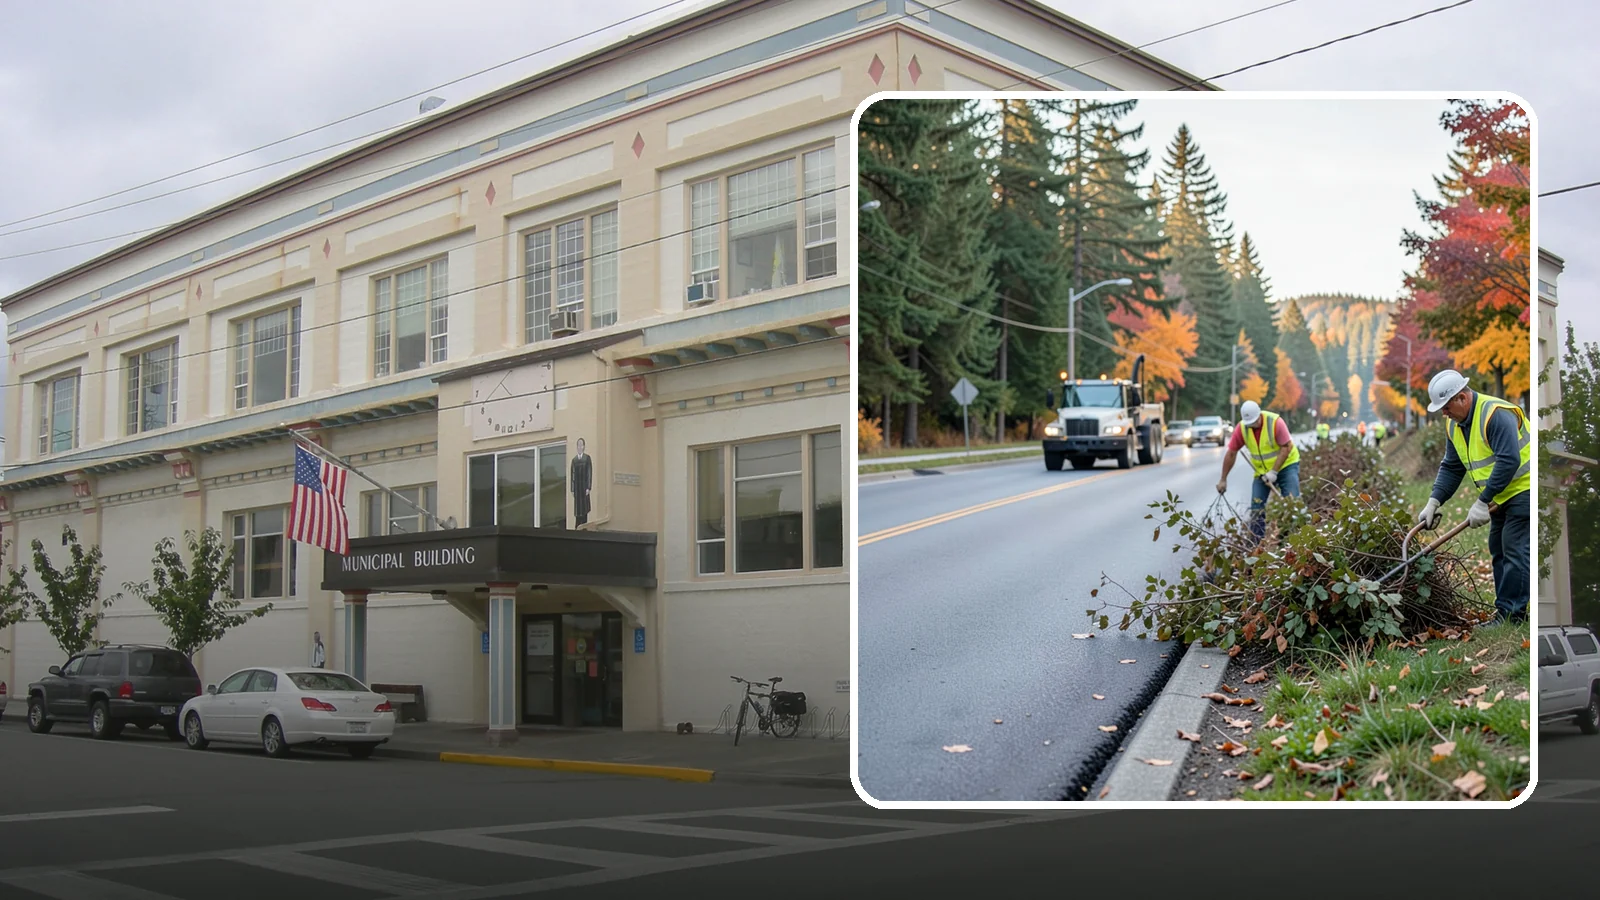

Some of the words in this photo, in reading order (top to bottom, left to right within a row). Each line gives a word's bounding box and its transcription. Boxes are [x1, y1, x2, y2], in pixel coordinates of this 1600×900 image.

[476, 390, 479, 398] 7
[536, 402, 540, 410] 4
[480, 407, 485, 415] 8
[488, 418, 492, 426] 9
[528, 414, 533, 422] 3
[494, 424, 500, 432] 10
[520, 420, 526, 428] 2
[502, 426, 506, 434] 11
[342, 552, 405, 572] MUNICIPAL
[415, 546, 475, 567] BUILDING
